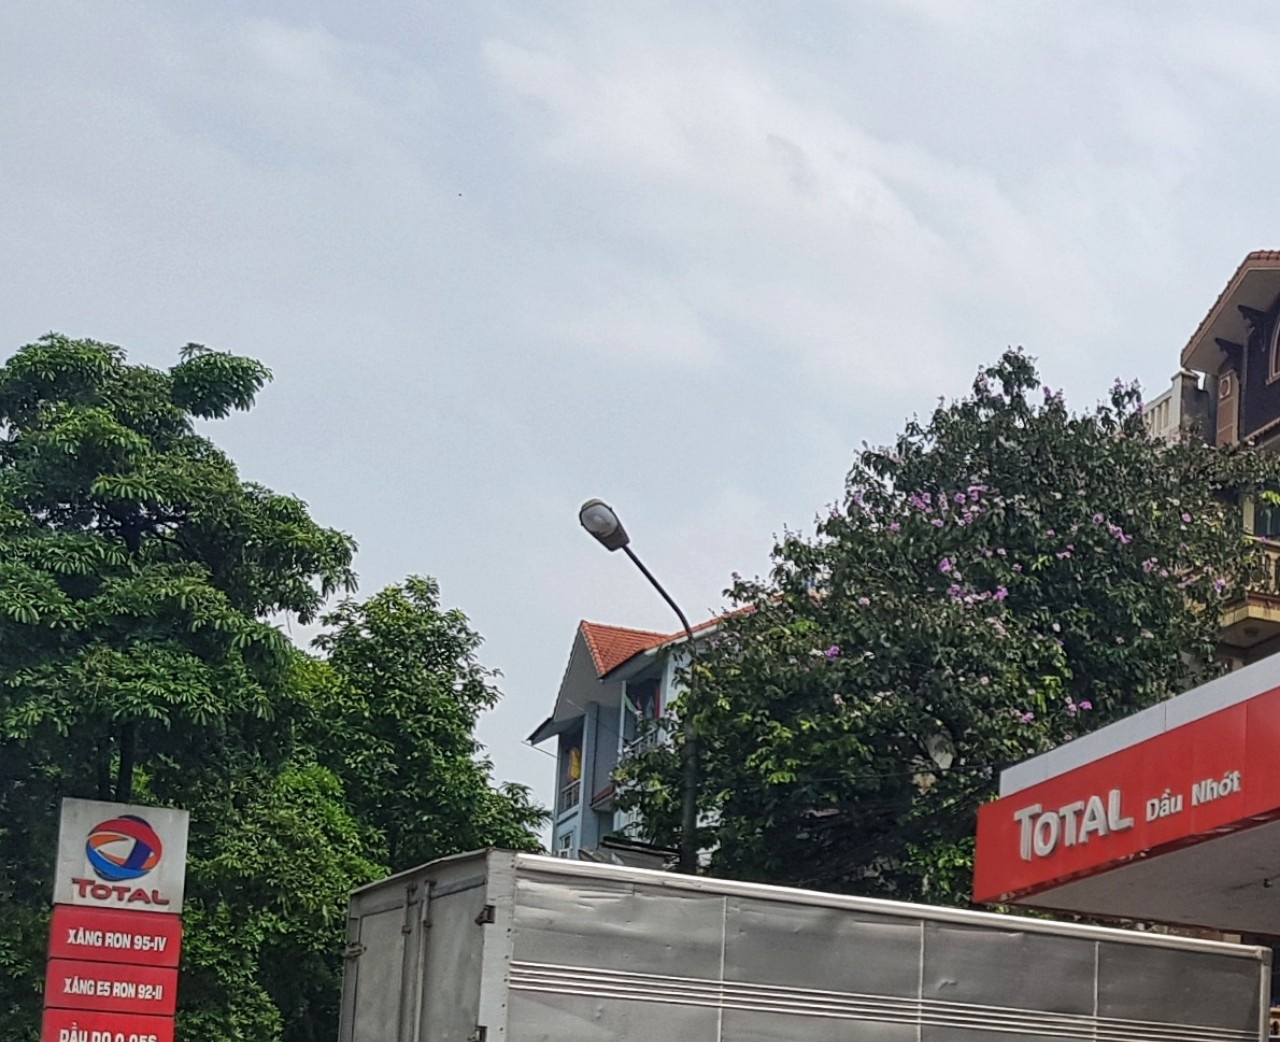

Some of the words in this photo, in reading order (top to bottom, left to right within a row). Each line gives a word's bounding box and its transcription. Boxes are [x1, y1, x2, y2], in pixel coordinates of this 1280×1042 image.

[1146, 789, 1183, 822] Dầu
[1191, 770, 1242, 806] Nhớt
[1014, 789, 1134, 861] TOTAL
[71, 878, 170, 906] TOTAL
[67, 927, 102, 947] XĂNG
[105, 932, 131, 949] RON
[133, 934, 167, 952] 95-IV
[63, 976, 95, 996] XĂNG
[96, 980, 111, 997] E5
[112, 980, 136, 999] RON
[137, 984, 163, 1000] 92-II
